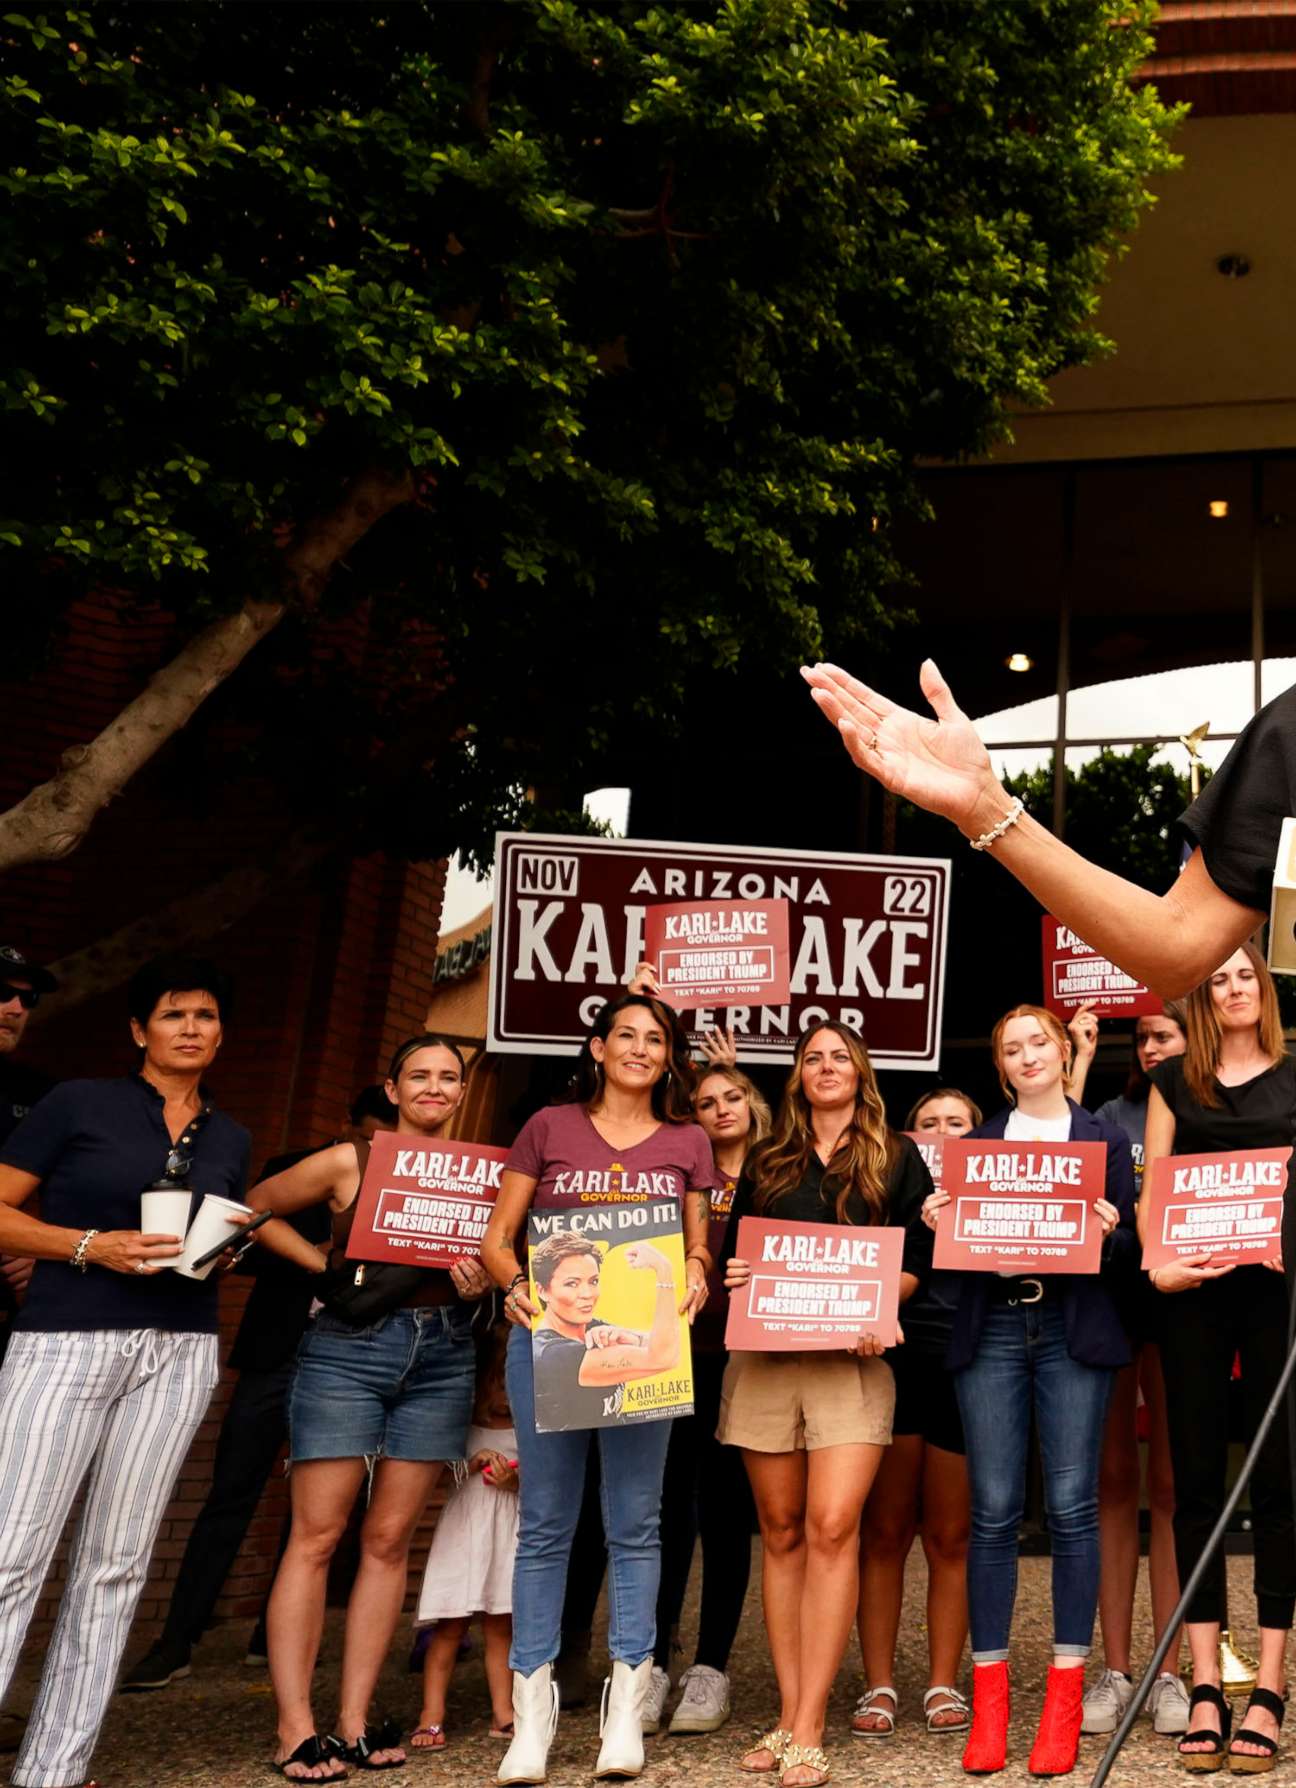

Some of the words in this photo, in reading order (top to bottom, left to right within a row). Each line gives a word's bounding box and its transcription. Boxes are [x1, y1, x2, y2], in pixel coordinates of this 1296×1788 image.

[521, 858, 577, 889] NOV
[630, 867, 832, 906] ARIZONA
[890, 880, 928, 913] 22
[665, 912, 711, 939] KARI
[718, 911, 768, 935] LAKE
[687, 934, 743, 944] GOVERNOR
[680, 951, 736, 967] ENDORSED
[739, 951, 753, 963] BY
[790, 915, 929, 999] AKE
[668, 966, 726, 982] PRESIDENT
[729, 964, 767, 978] TRUMP
[1067, 961, 1112, 978] ENDORSED
[1058, 976, 1103, 993] PRESIDENT
[393, 1150, 453, 1179] KARI
[459, 1156, 504, 1188] LAK
[965, 1154, 1019, 1184] KARI
[1027, 1154, 1083, 1186] LAKE
[1173, 1164, 1223, 1194] KARI
[1230, 1161, 1282, 1186] LAKE
[418, 1177, 484, 1195] GOVERNOR
[553, 1171, 610, 1195] KARI
[621, 1172, 677, 1196] LAKE
[989, 1181, 1053, 1193] GOVERNOR
[1195, 1185, 1255, 1199] GOVERNOR
[580, 1192, 648, 1202] GOVERNOR
[403, 1196, 469, 1220] ENDORSED
[473, 1207, 491, 1222] BY
[532, 1215, 565, 1234] WE
[570, 1212, 612, 1232] CAN
[618, 1207, 647, 1228] DO
[653, 1203, 677, 1224] IT!
[979, 1202, 1043, 1220] ENDORSED
[1045, 1204, 1064, 1221] BY
[1186, 1205, 1246, 1223] ENDORSED
[1248, 1203, 1264, 1219] BY
[383, 1211, 456, 1235] PRESIDENT
[457, 1221, 488, 1238] TRU
[963, 1218, 1031, 1237] PRESIDENT
[1032, 1221, 1077, 1239] TRUMP
[1171, 1221, 1234, 1239] PRESIDENT
[1235, 1217, 1277, 1234] TRUMP
[388, 1237, 412, 1247] TEXT
[414, 1240, 445, 1251] "KARI"
[447, 1245, 459, 1254] TO
[461, 1245, 481, 1255] 707
[762, 1235, 817, 1262] KARI
[823, 1237, 880, 1268] LAKE
[969, 1245, 992, 1254] TEXT
[1026, 1246, 1039, 1256] TO
[786, 1262, 850, 1274] GOVERNOR
[774, 1281, 839, 1300] ENDORSED
[841, 1285, 860, 1301] BY
[757, 1297, 827, 1315] PRESIDENT
[828, 1299, 872, 1316] TRUMP
[763, 1322, 786, 1332] TEXT
[820, 1324, 833, 1332] TO
[627, 1385, 656, 1402] KARI
[659, 1379, 691, 1395] LAKE
